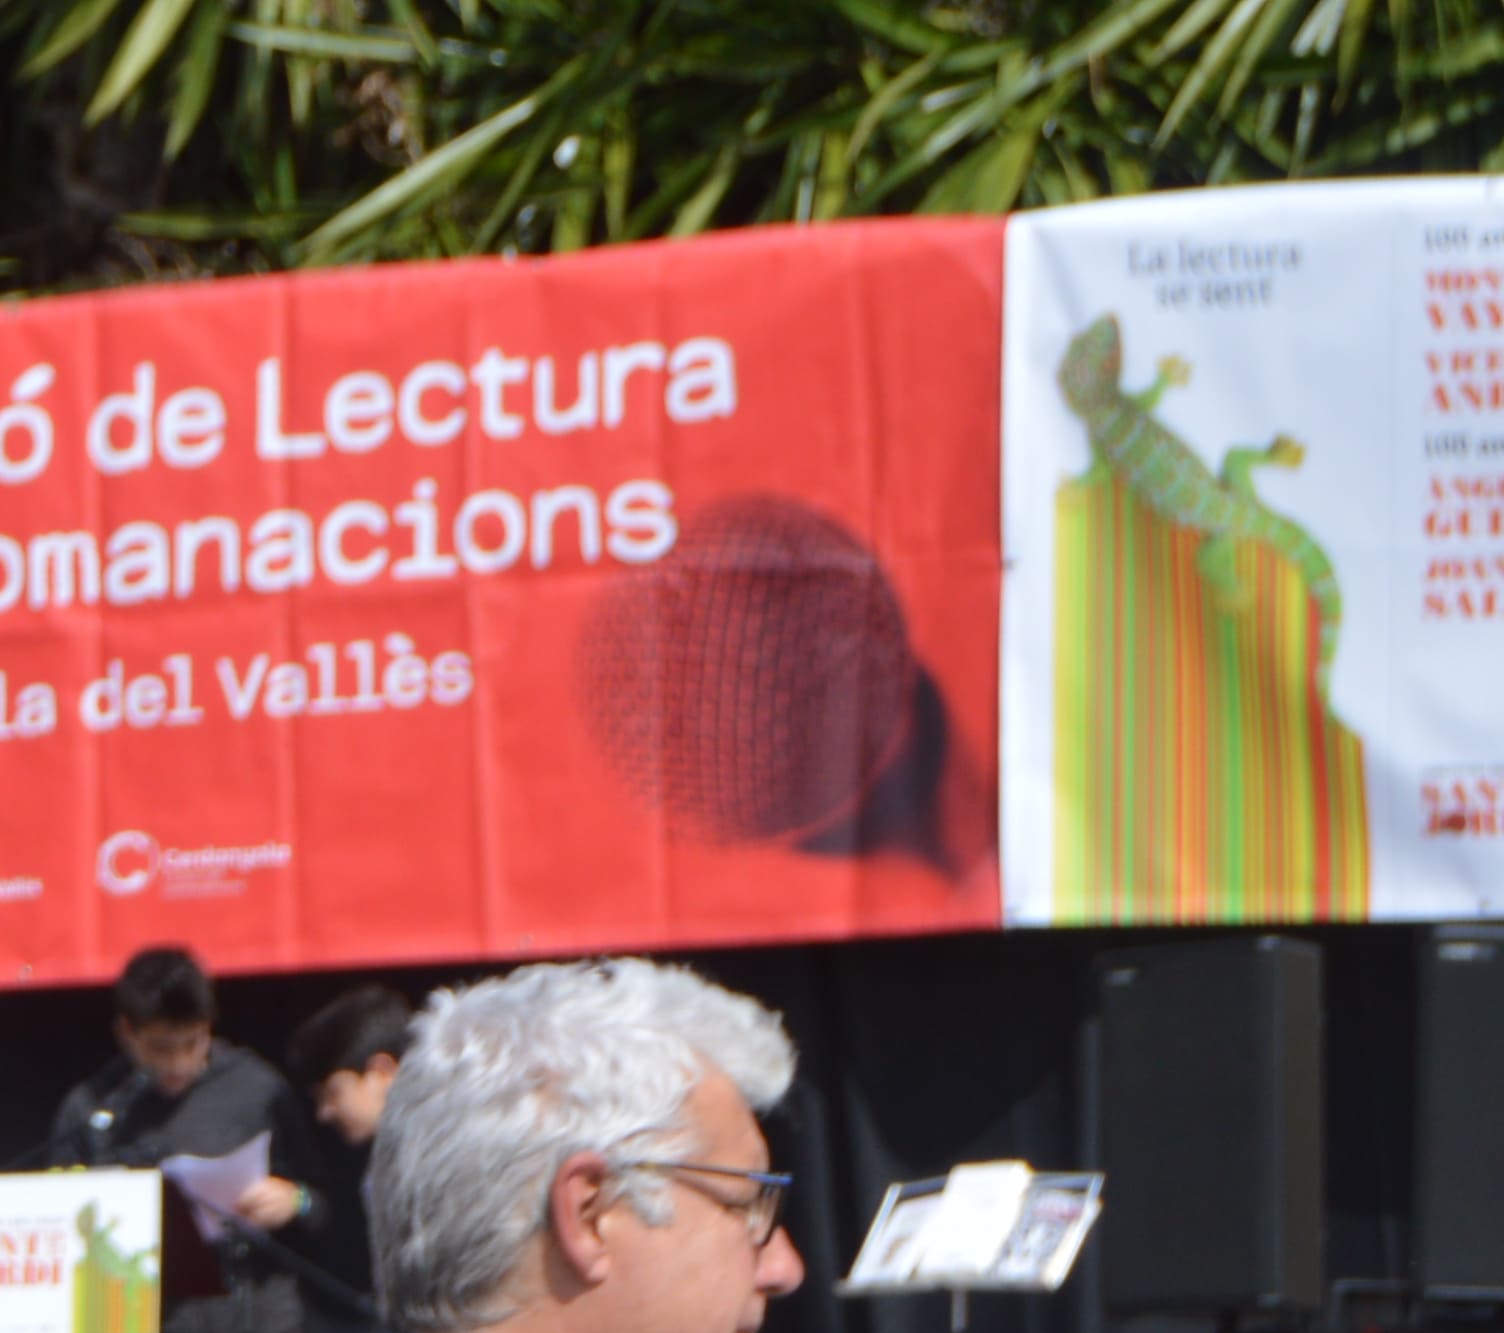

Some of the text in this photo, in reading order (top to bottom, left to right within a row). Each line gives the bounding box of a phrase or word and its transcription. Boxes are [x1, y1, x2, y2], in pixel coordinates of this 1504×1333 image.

[86, 359, 227, 476] de
[254, 336, 738, 462] Lectura
[79, 653, 205, 732] del
[214, 630, 474, 721] Vallès
